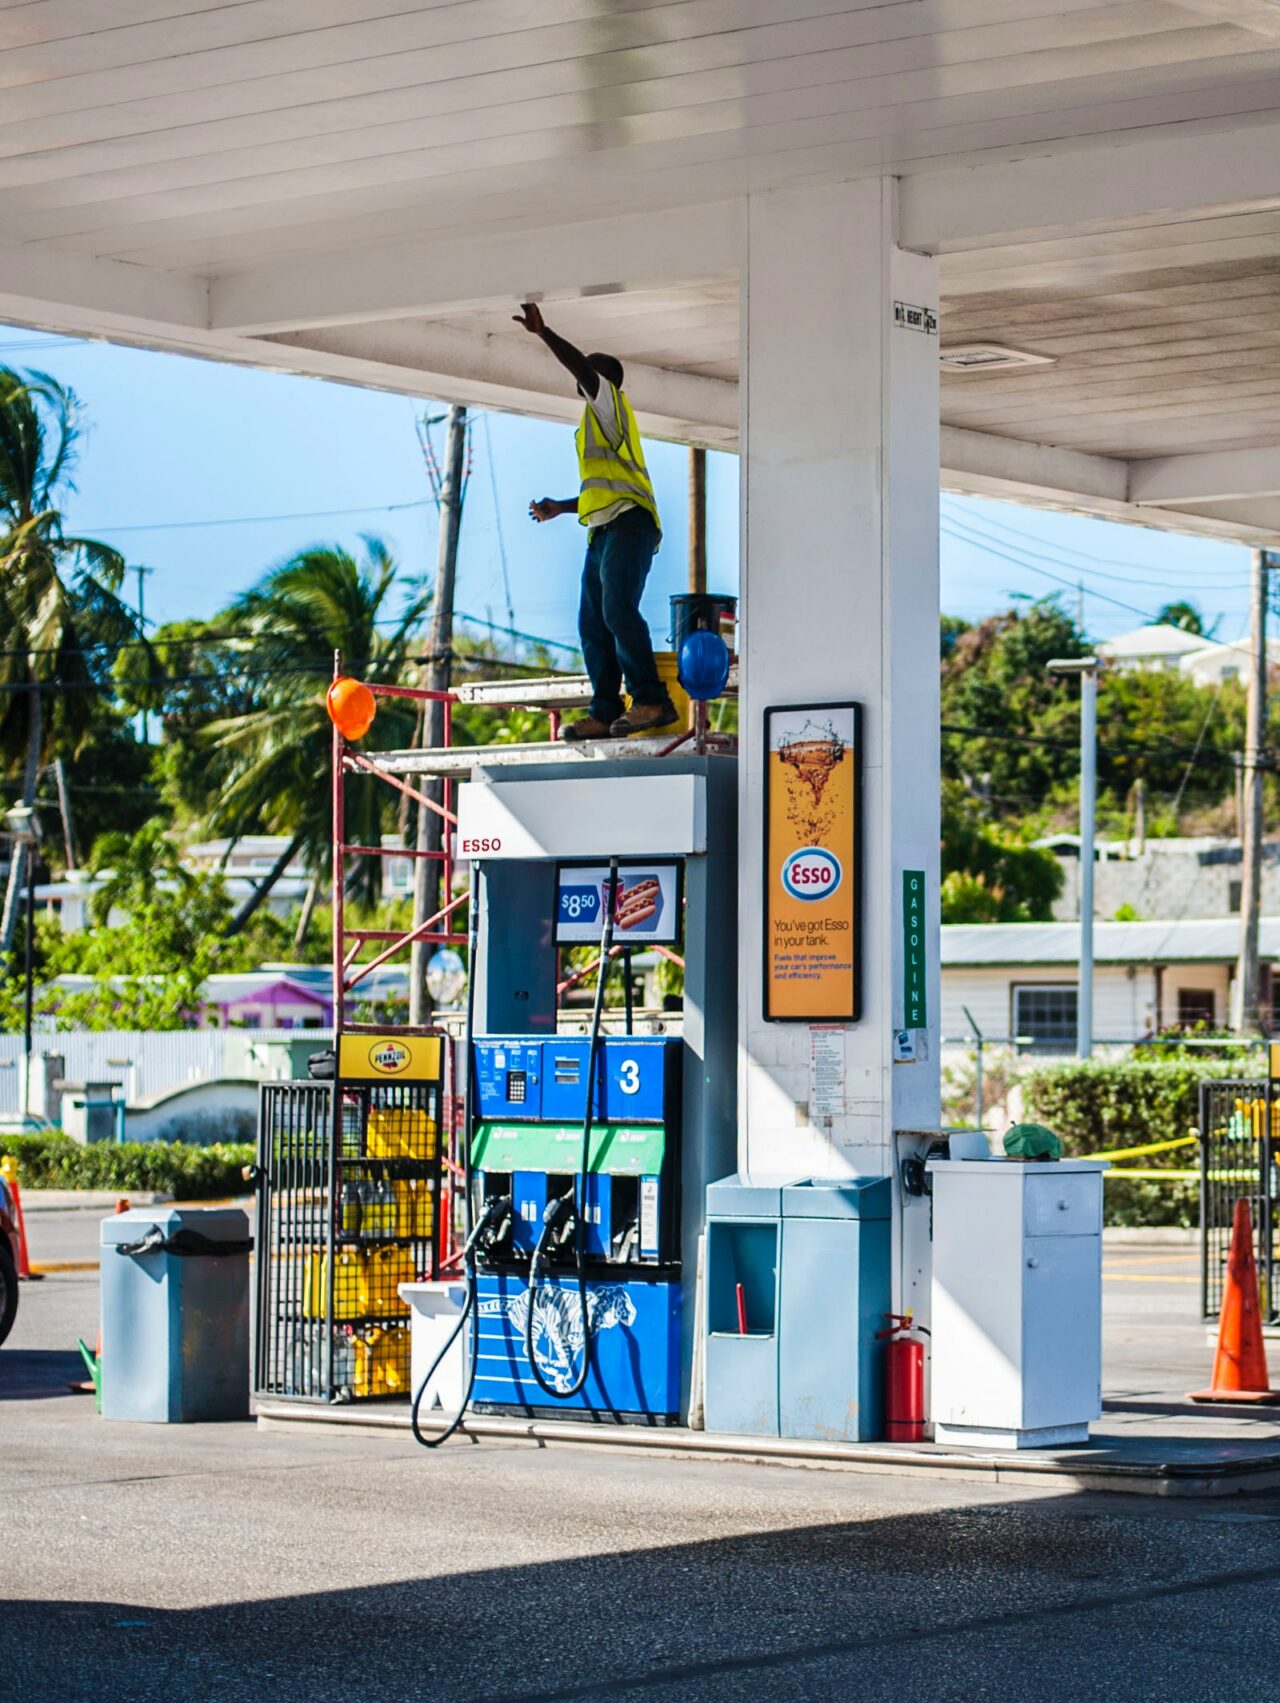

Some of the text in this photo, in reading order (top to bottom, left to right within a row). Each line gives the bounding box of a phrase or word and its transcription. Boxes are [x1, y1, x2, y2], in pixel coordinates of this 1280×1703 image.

[462, 838, 501, 852] ESSO
[791, 863, 831, 885] Esso
[774, 918, 850, 934] You've got Esso
[774, 934, 830, 949] in your tank.
[910, 878, 919, 1021] GASOLINE
[619, 1059, 640, 1095] 3
